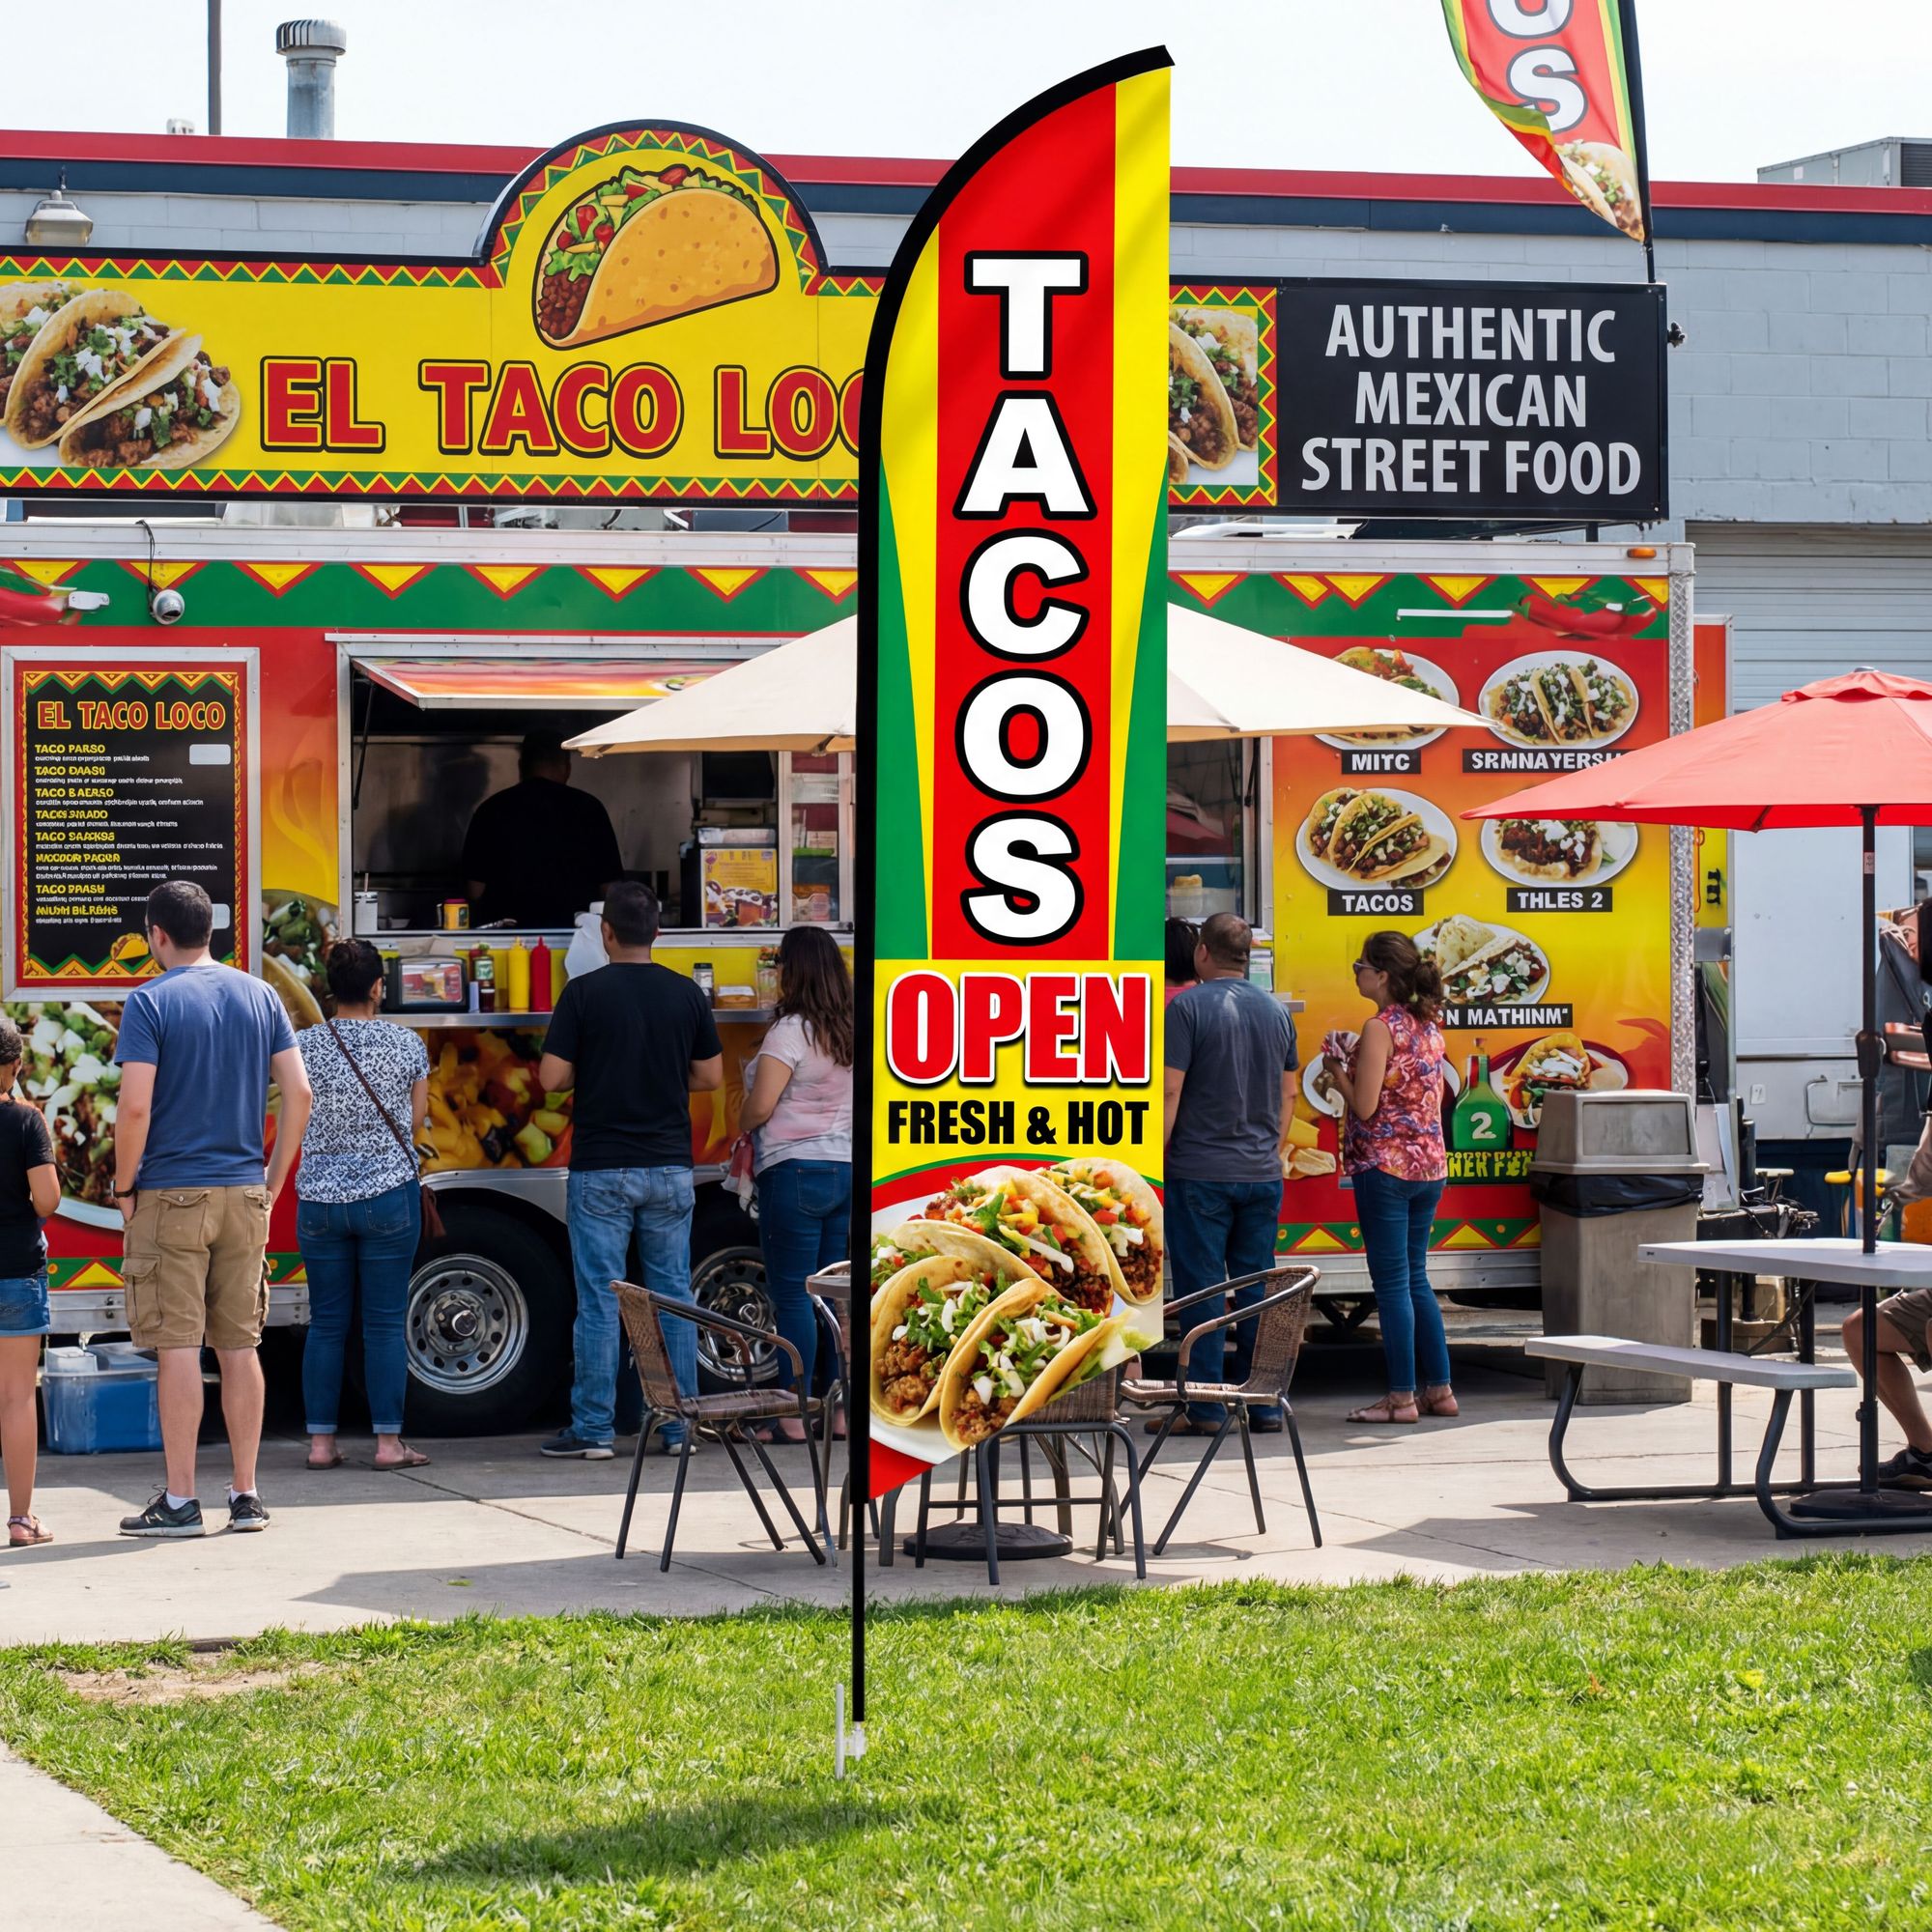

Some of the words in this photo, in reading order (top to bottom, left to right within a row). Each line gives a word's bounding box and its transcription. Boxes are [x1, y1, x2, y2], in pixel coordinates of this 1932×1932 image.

[1325, 304, 1615, 363] AUTHENTIC
[260, 355, 386, 454] EL
[418, 358, 685, 460] TACO
[1354, 371, 1586, 428] MEXICAN
[1301, 438, 1489, 493] STREET
[1505, 440, 1641, 496] FOOD
[953, 251, 1097, 947] TACOS
[37, 701, 71, 729] EL
[77, 701, 149, 730] TACO
[156, 701, 227, 730] LOCO
[35, 744, 65, 753] TACO
[35, 766, 65, 776] TACO
[35, 787, 66, 798] TACO
[36, 832, 66, 841] TACO
[36, 884, 66, 895] TACO
[1517, 892, 1584, 910] THLES
[1591, 892, 1604, 909] 2
[1342, 895, 1414, 913] TACOS
[887, 969, 1151, 1086] OPEN
[889, 1099, 1014, 1146] FRESH
[1026, 1106, 1057, 1145] &
[1067, 1100, 1150, 1146] HOT
[1470, 1112, 1496, 1139] 2
